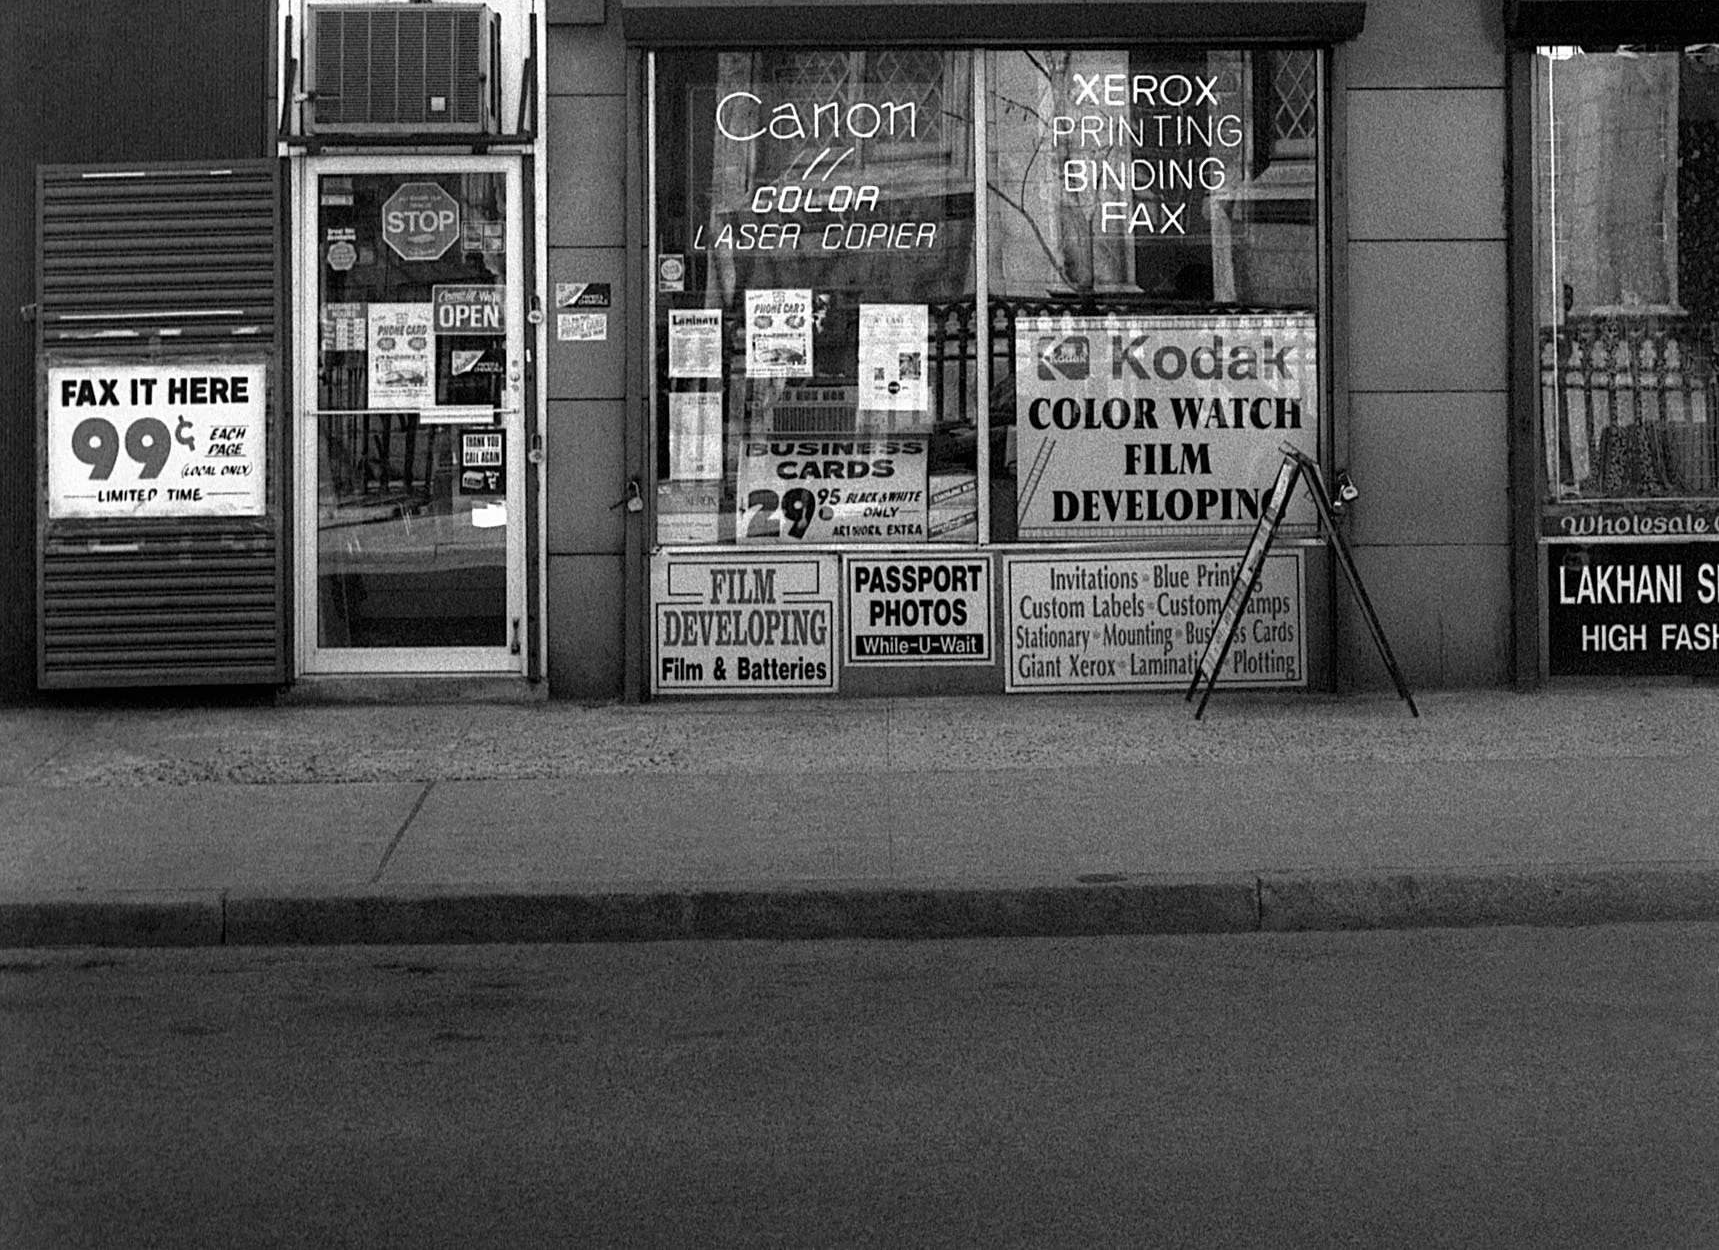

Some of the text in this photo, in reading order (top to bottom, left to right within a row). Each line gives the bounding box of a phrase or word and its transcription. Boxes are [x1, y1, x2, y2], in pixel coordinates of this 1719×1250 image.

[1074, 74, 1216, 105] XEROX
[717, 93, 915, 140] Canon
[1054, 116, 1241, 146] PRINTING
[1065, 158, 1224, 191] BINDING
[752, 186, 879, 212] COLOR
[387, 211, 455, 233] STOP
[1102, 202, 1184, 233] FAX
[695, 224, 935, 249] LASER COPIER
[439, 304, 500, 329] OPEN
[1112, 335, 1296, 381] Kodak
[62, 377, 248, 407] FAX IT HERE
[1029, 398, 1303, 430] COLOR WATCH
[210, 427, 246, 441] EACH
[208, 443, 243, 455] PAGE
[746, 442, 924, 458] BUSINESS
[1125, 443, 1211, 475] FILM
[777, 460, 894, 480] CARDS
[167, 488, 202, 501] TIME
[817, 488, 841, 506] 95
[845, 491, 878, 505] BLACK
[888, 490, 923, 503] WHITE
[863, 507, 899, 518] ONLY
[1561, 514, 1709, 535] Wholesale
[832, 525, 883, 538] ARTWORK
[887, 524, 924, 536] EXTRA
[710, 569, 776, 604] FILM
[852, 560, 982, 593] PASSPORT
[1051, 562, 1262, 592] Invitations Blue Printg
[1560, 564, 1719, 603] LAKHANI S
[870, 599, 967, 626] PHOTOS
[1020, 592, 1290, 621] Custom Labels Custom amps
[664, 609, 827, 646] DEVELOPING
[1016, 619, 1294, 655] Stationary Mounting Busss Cards
[1582, 625, 1646, 651] HIGH
[863, 636, 976, 654] While-U-Wait
[662, 657, 826, 681] Film & Batteries
[1018, 648, 1296, 679] Giant Xerox Laminati Plotting
